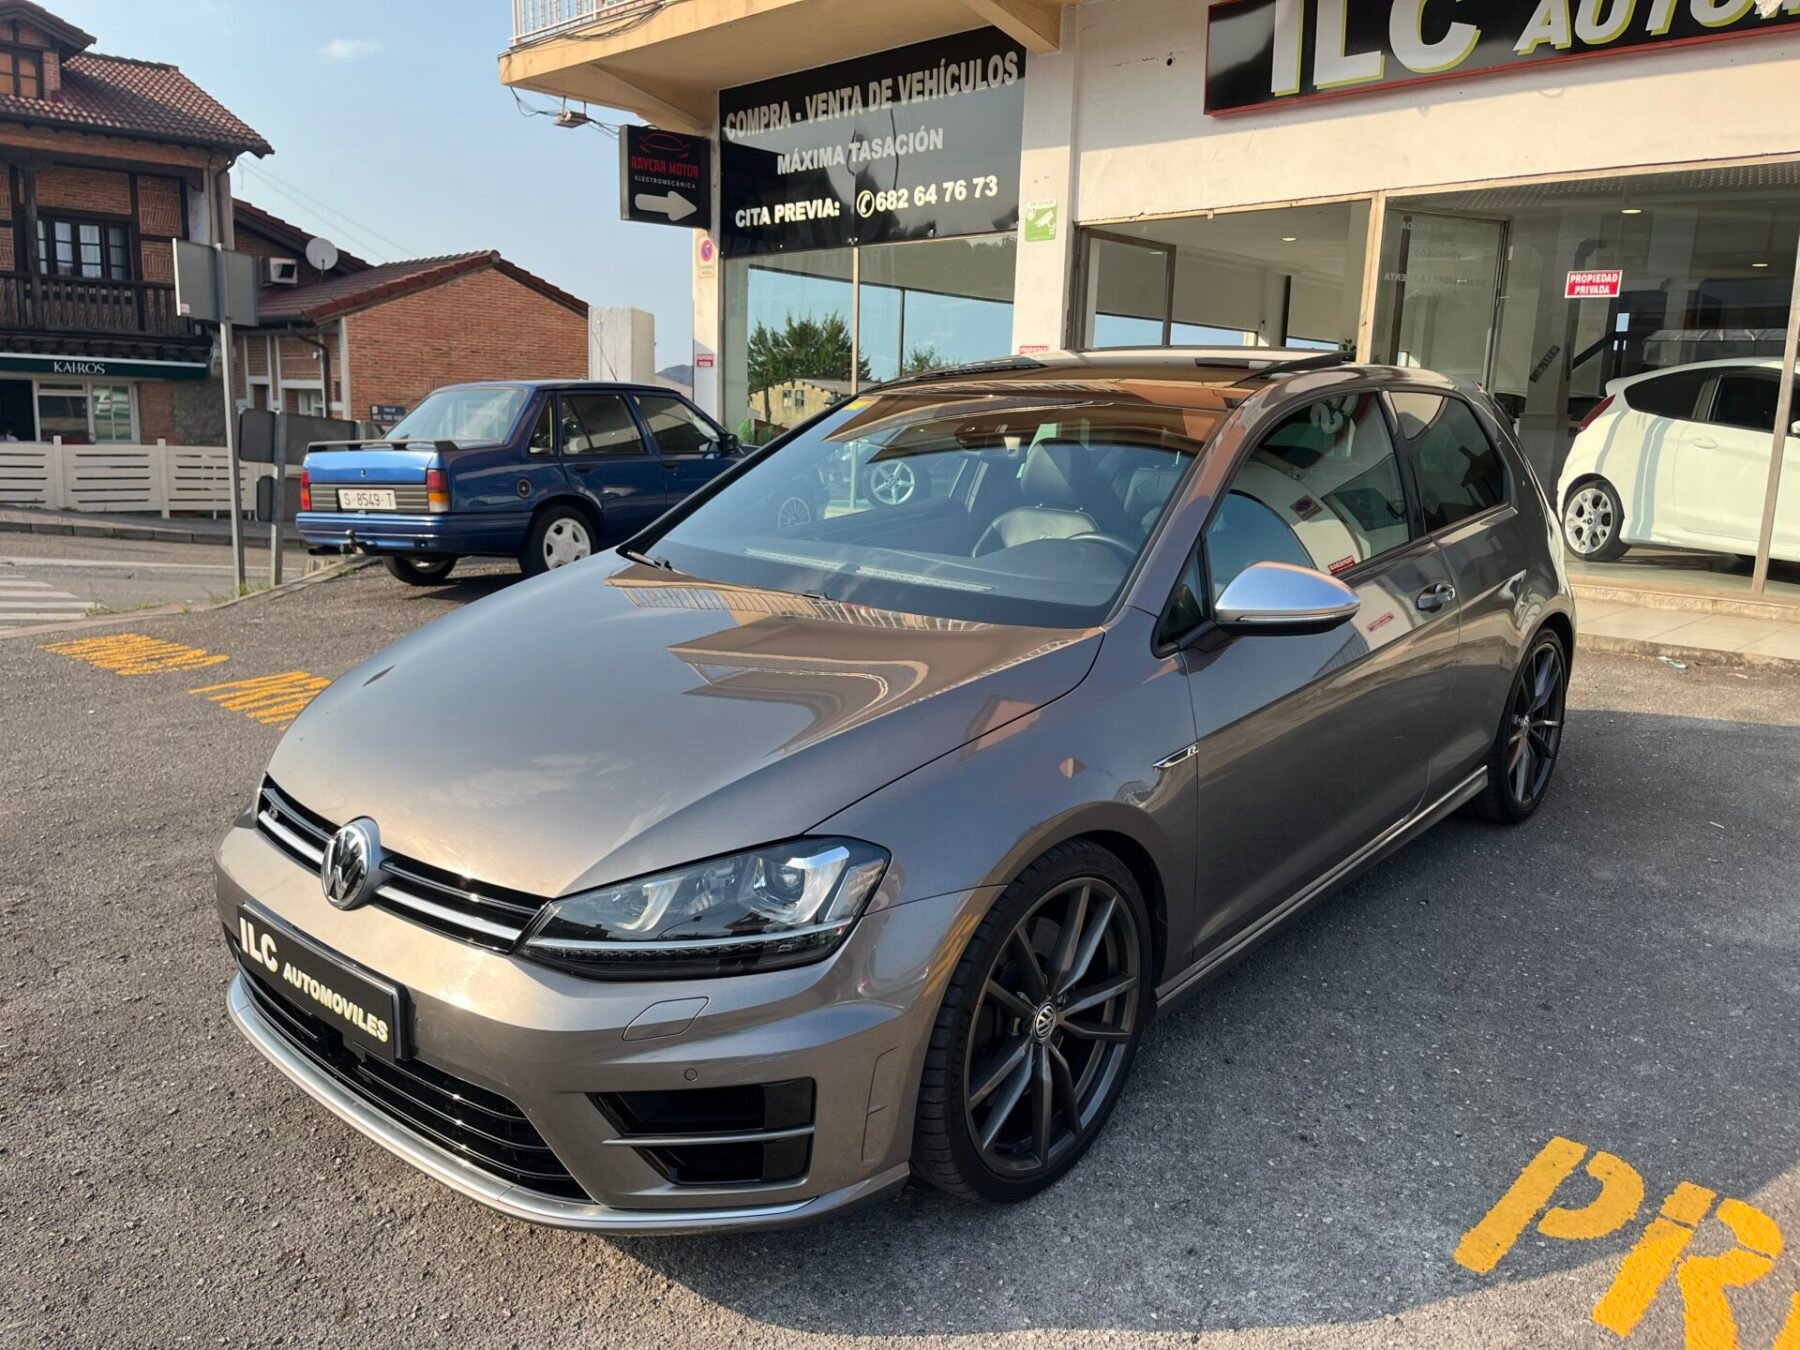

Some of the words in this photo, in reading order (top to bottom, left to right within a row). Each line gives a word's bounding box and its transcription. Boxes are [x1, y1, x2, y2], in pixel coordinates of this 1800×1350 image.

[1512, 0, 1800, 55] AUT
[724, 107, 792, 140] COMPRA
[804, 84, 863, 125] VENTA
[868, 78, 893, 112] DE
[898, 50, 1019, 106] VEHÍCULOS
[668, 161, 700, 178] MOTOR
[776, 144, 845, 176] MÁXIMA
[849, 125, 944, 164] TASACIÓN
[735, 204, 771, 228] CITA
[774, 197, 840, 224] PREVIA:
[875, 188, 909, 213] 682
[913, 183, 937, 207] 64
[943, 178, 967, 202] 76
[972, 174, 998, 199] 73
[1570, 273, 1618, 284] PROPIEDAD
[1574, 284, 1610, 295] PRIVADA
[239, 916, 280, 974] ILC
[282, 961, 390, 1043] AUTOMOVILES
[1453, 1136, 1800, 1350] PR
